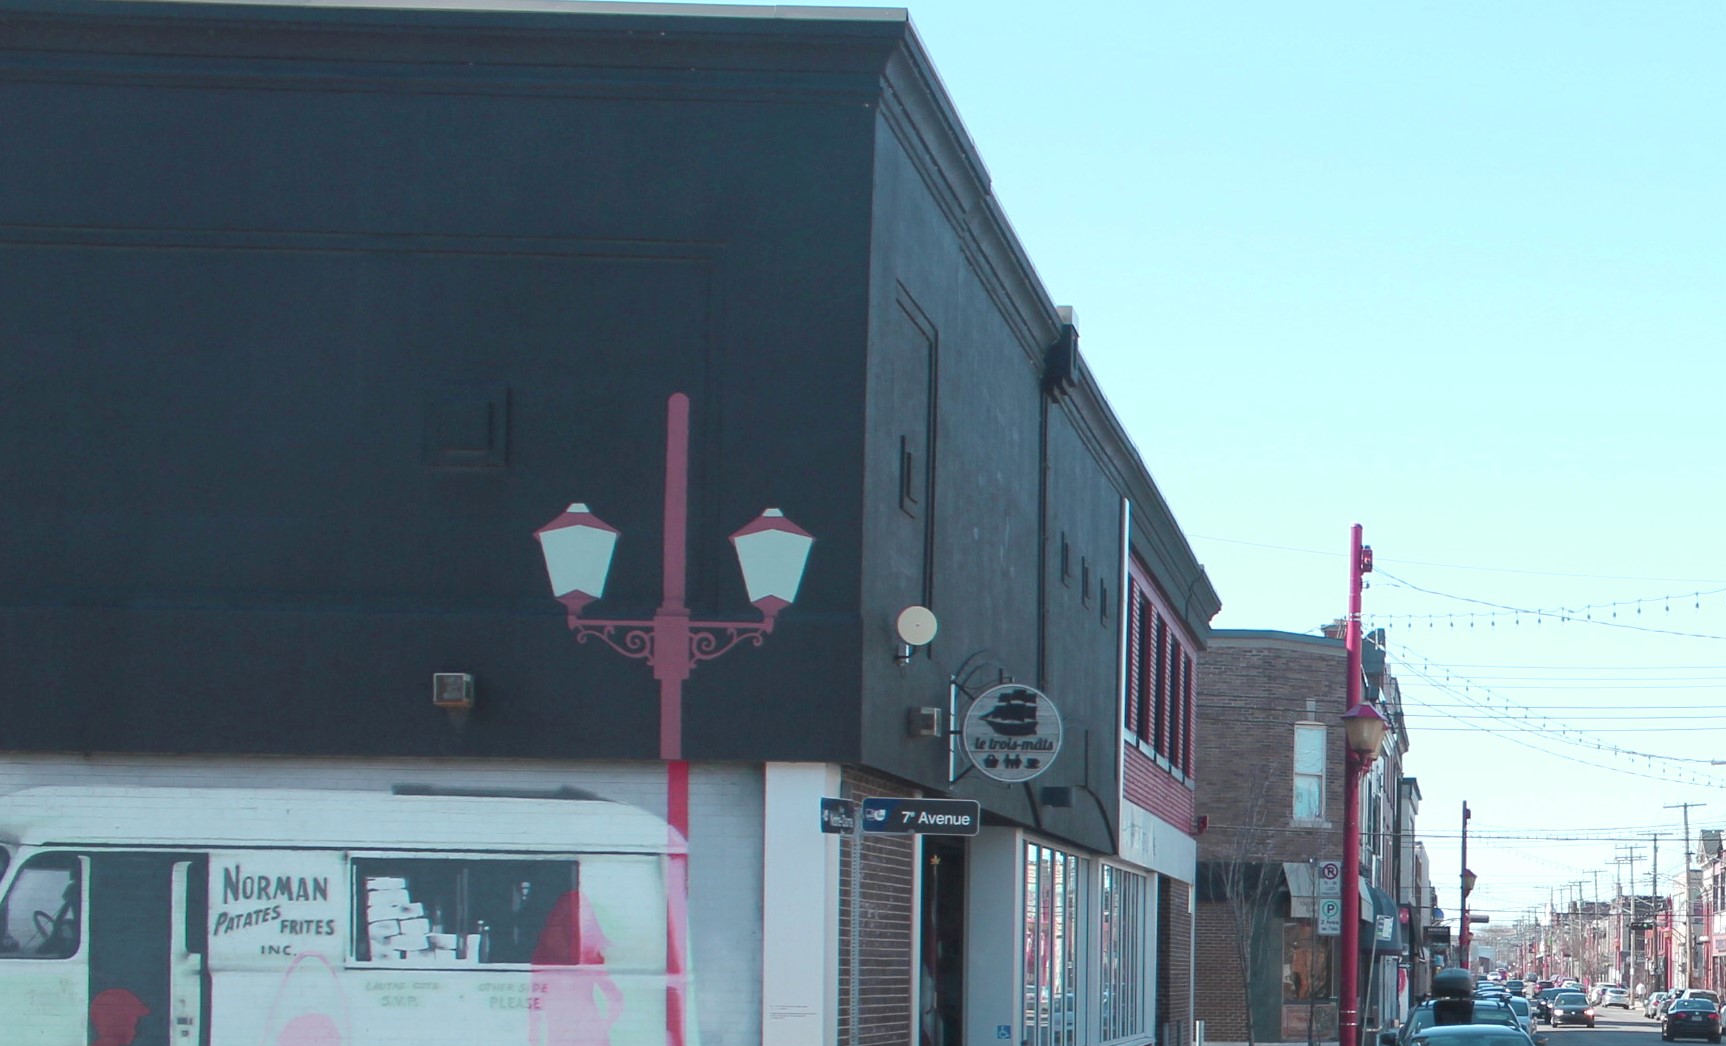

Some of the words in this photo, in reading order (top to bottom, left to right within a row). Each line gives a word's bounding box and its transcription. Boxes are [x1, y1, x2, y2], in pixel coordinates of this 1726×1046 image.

[974, 736, 986, 750] le
[918, 812, 971, 826] Avenue
[223, 864, 328, 904] NORMAN
[213, 905, 281, 936] PATATES
[280, 919, 335, 936] FRITES
[261, 945, 297, 956] INC.
[488, 996, 541, 1009] PLEASE
